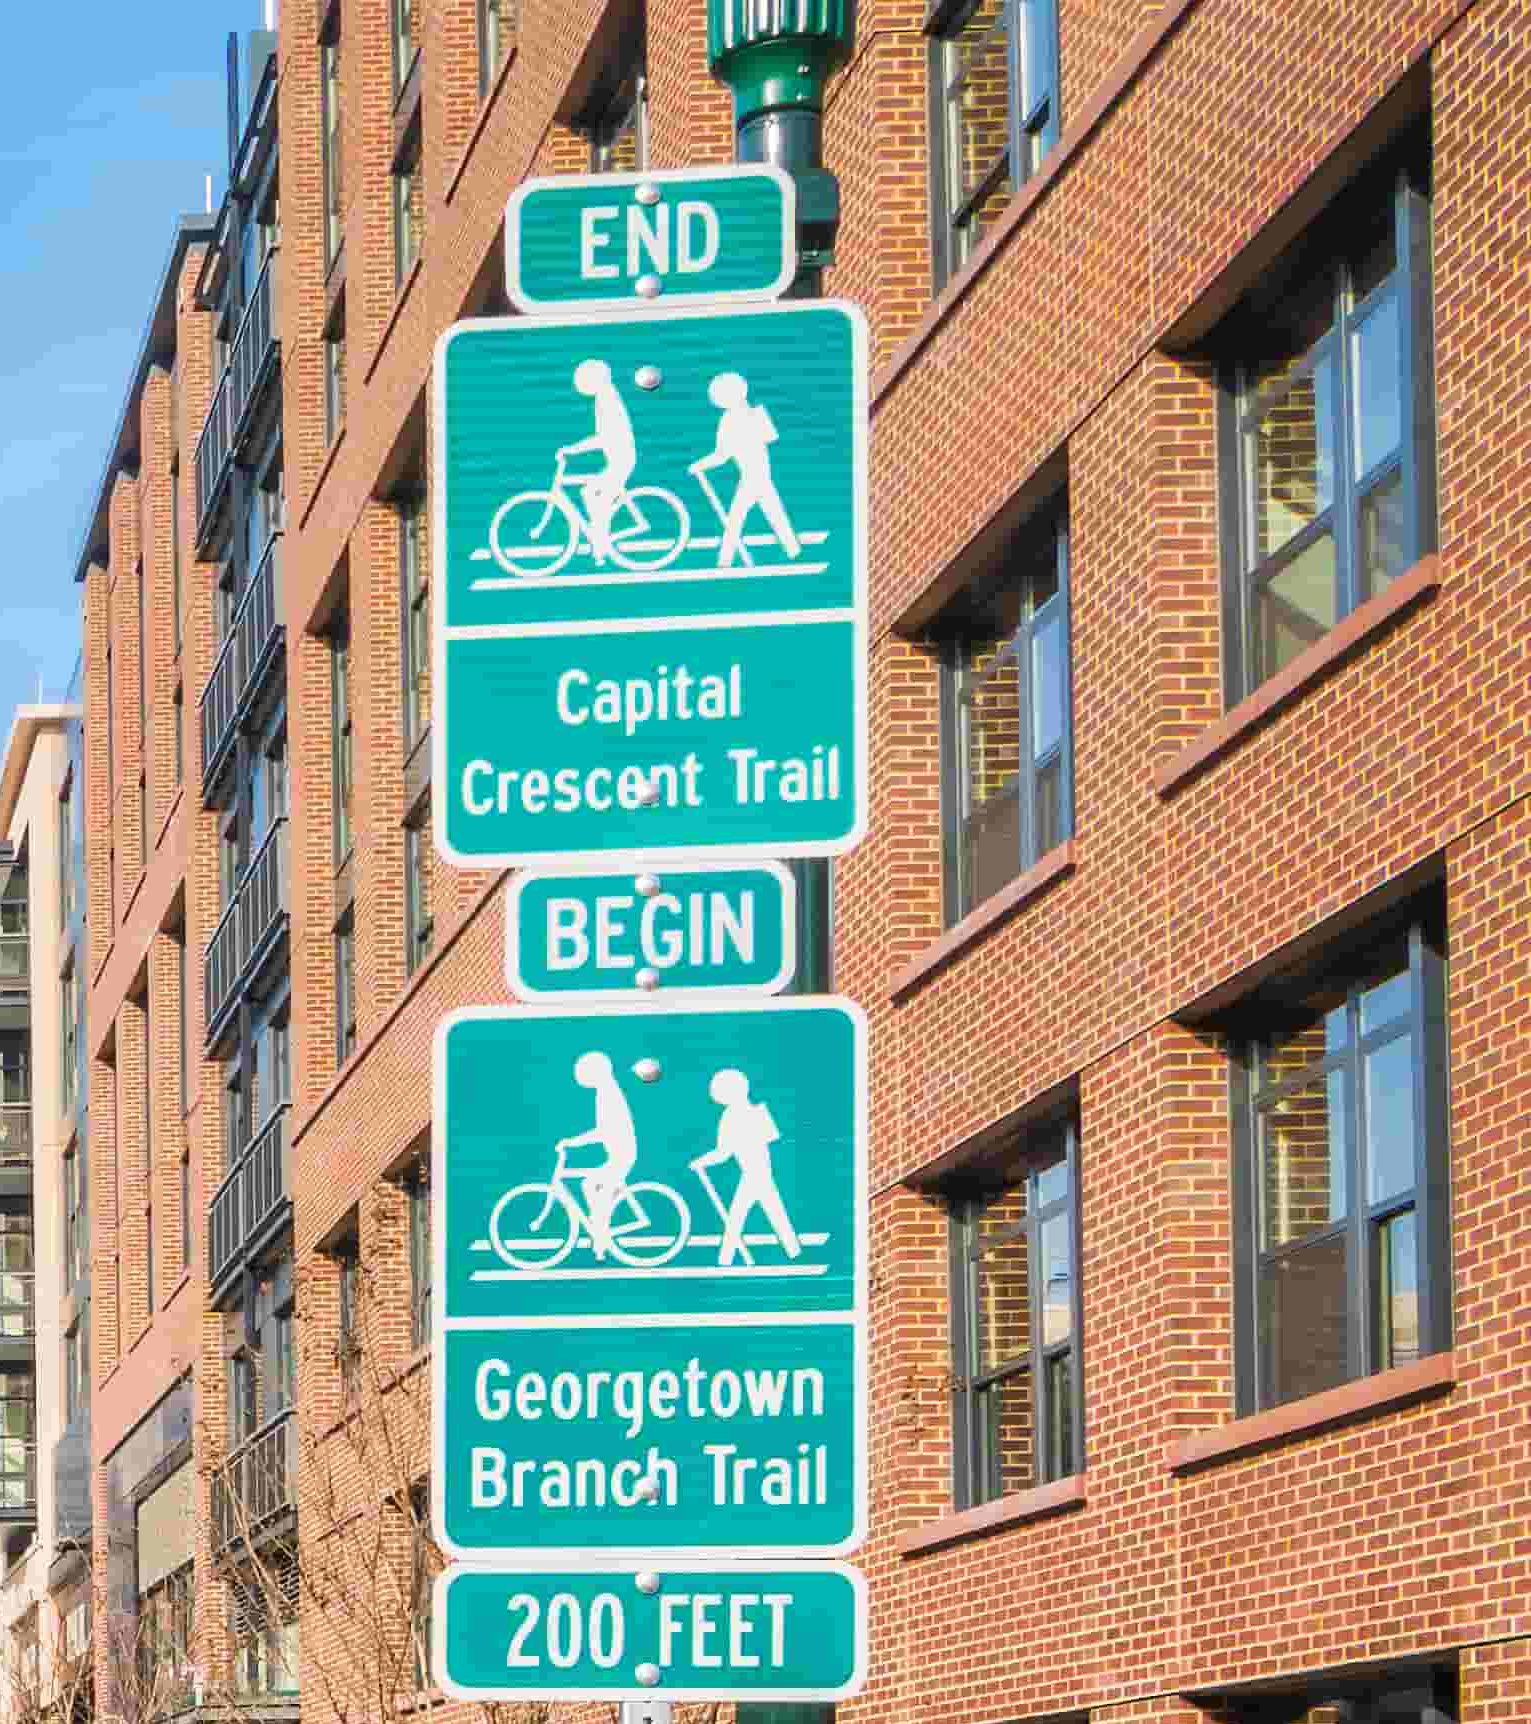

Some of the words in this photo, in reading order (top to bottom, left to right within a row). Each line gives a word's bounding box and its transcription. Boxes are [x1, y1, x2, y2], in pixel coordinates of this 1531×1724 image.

[581, 201, 719, 279] END
[557, 663, 741, 737] Capital
[461, 752, 703, 816] Crescent
[727, 744, 840, 804] Trail
[546, 891, 754, 970] BEGIN
[475, 1358, 824, 1438] Georgetown
[471, 1447, 678, 1508] Branch
[703, 1443, 828, 1505] Trail
[506, 1592, 625, 1668] 200
[658, 1593, 793, 1667] FEET
